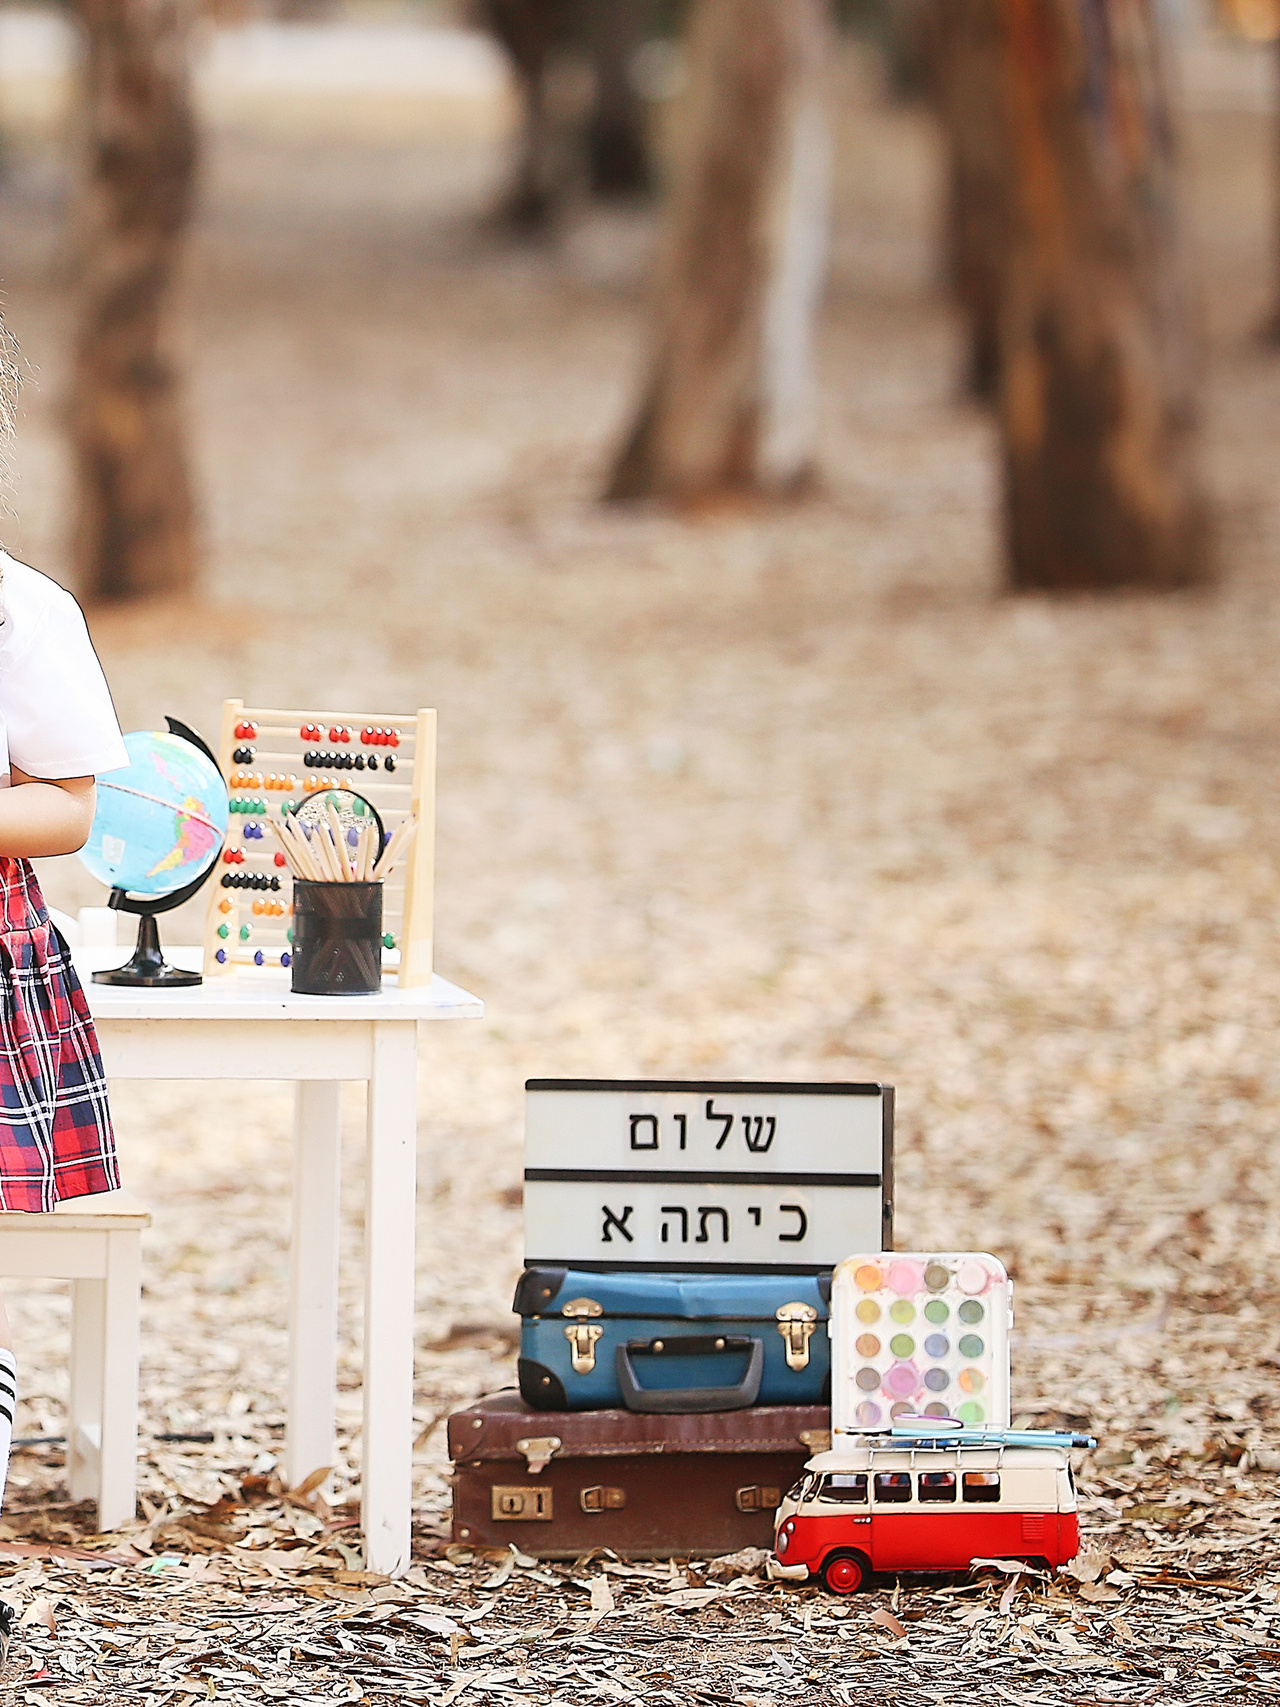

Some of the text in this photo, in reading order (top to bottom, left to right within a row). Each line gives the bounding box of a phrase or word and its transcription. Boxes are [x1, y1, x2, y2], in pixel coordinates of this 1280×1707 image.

[629, 1099, 776, 1152] שלום
[601, 1204, 808, 1242] כיתה א
